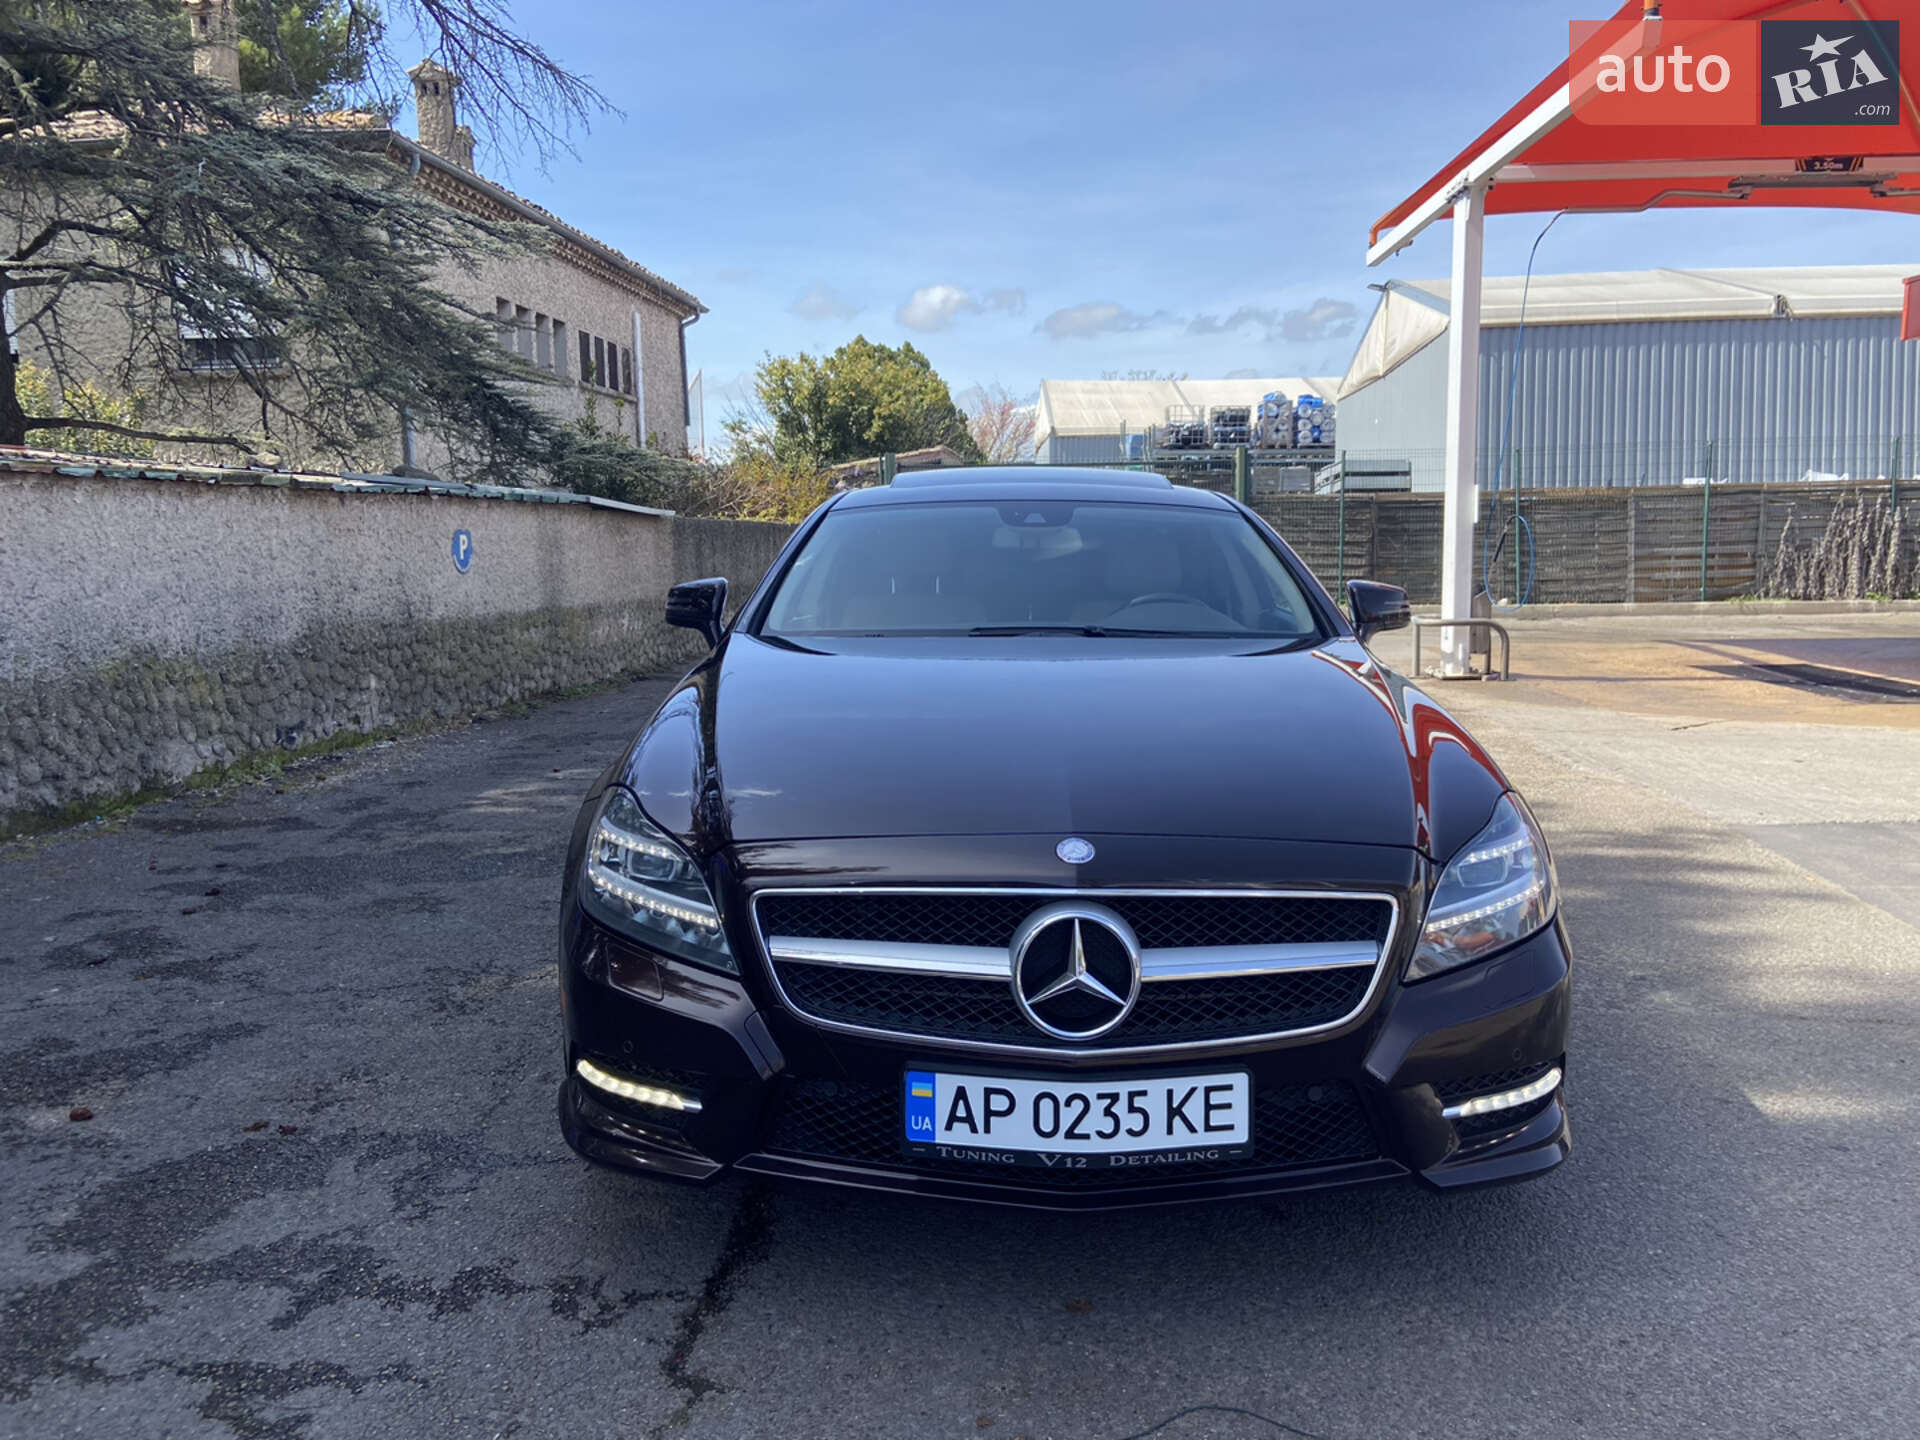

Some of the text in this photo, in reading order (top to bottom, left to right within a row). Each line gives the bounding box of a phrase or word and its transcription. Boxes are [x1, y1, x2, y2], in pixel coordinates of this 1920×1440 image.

[459, 534, 469, 560] P
[944, 1084, 1235, 1140] AP 0235 KE
[911, 1115, 932, 1132] UA
[1036, 1152, 1087, 1169] V12
